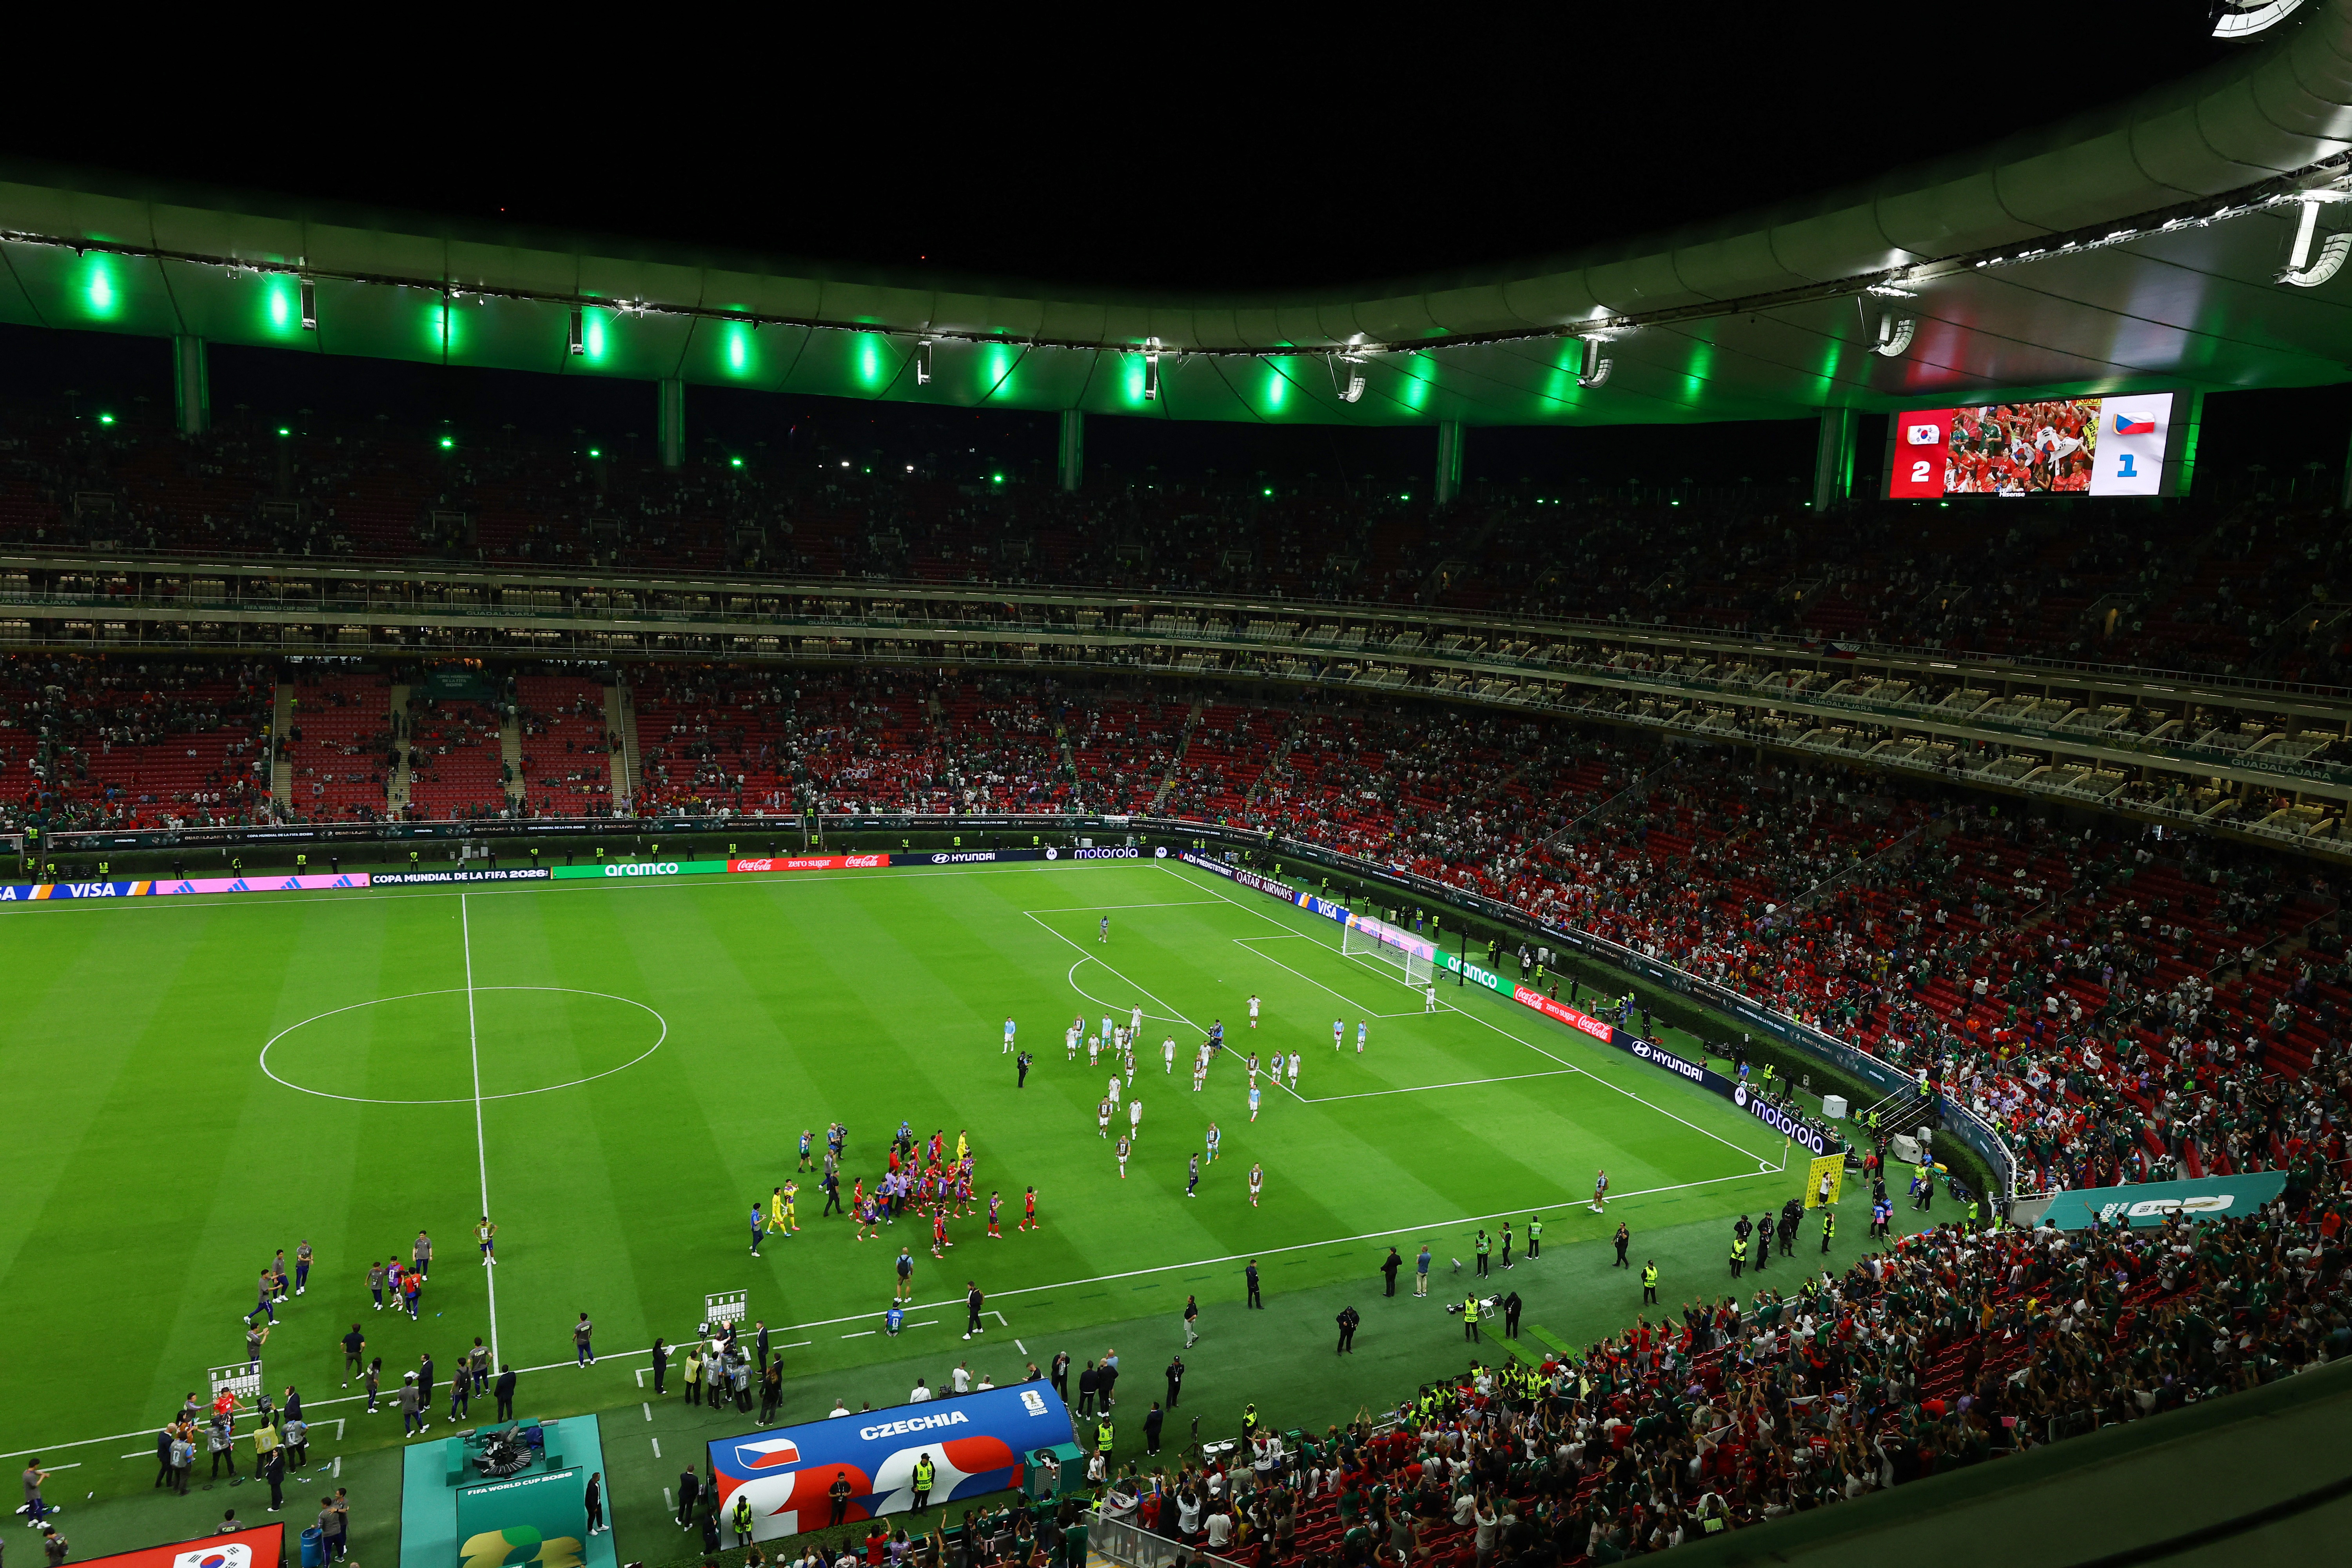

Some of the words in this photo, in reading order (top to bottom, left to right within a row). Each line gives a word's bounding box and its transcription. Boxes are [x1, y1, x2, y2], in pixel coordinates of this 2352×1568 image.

[1911, 461, 1931, 482] 2
[2118, 454, 2137, 477] 1
[1466, 657, 1517, 666] GUADALAJARA
[1809, 698, 1873, 712] GUADALAJARA
[2231, 758, 2331, 780] GUADALAJARA
[951, 852, 995, 861] HYUNDAI
[1074, 846, 1138, 859] motorola
[605, 862, 679, 877] aramco
[737, 858, 773, 871] Coca-Cola
[808, 858, 831, 869] sugar
[846, 855, 880, 868] Coca-Cola
[1183, 853, 1196, 864] ADI
[1196, 857, 1232, 877] PREDICTSTREET
[372, 874, 403, 884] COPA
[404, 873, 452, 882] MUNDIAL
[454, 872, 468, 880] DE
[470, 871, 483, 880] LA
[485, 870, 508, 879] FIFA
[1236, 871, 1260, 889] QATAR
[1262, 881, 1293, 901] AIRWAYS
[65, 883, 116, 898] VISA
[1318, 900, 1337, 920] VISA
[1515, 987, 1544, 1010] Coca-Cola
[1546, 1003, 1559, 1014] zero
[1559, 1008, 1576, 1022] sugar
[1578, 1015, 1608, 1039] Coca-Cola
[1745, 1010, 1758, 1019] MUNDIAL
[1774, 1024, 1785, 1032] 2026
[1653, 1049, 1703, 1082] HYUNDAI
[1751, 1099, 1824, 1155] motorola
[860, 1411, 969, 1440] CZECHIA
[1814, 1445, 1825, 1458] 15
[467, 1486, 488, 1495] FIFA
[488, 1482, 521, 1493] WORLD
[522, 1478, 540, 1488] CUP
[541, 1472, 573, 1482] 2026
[1356, 1537, 1366, 1547] 20
